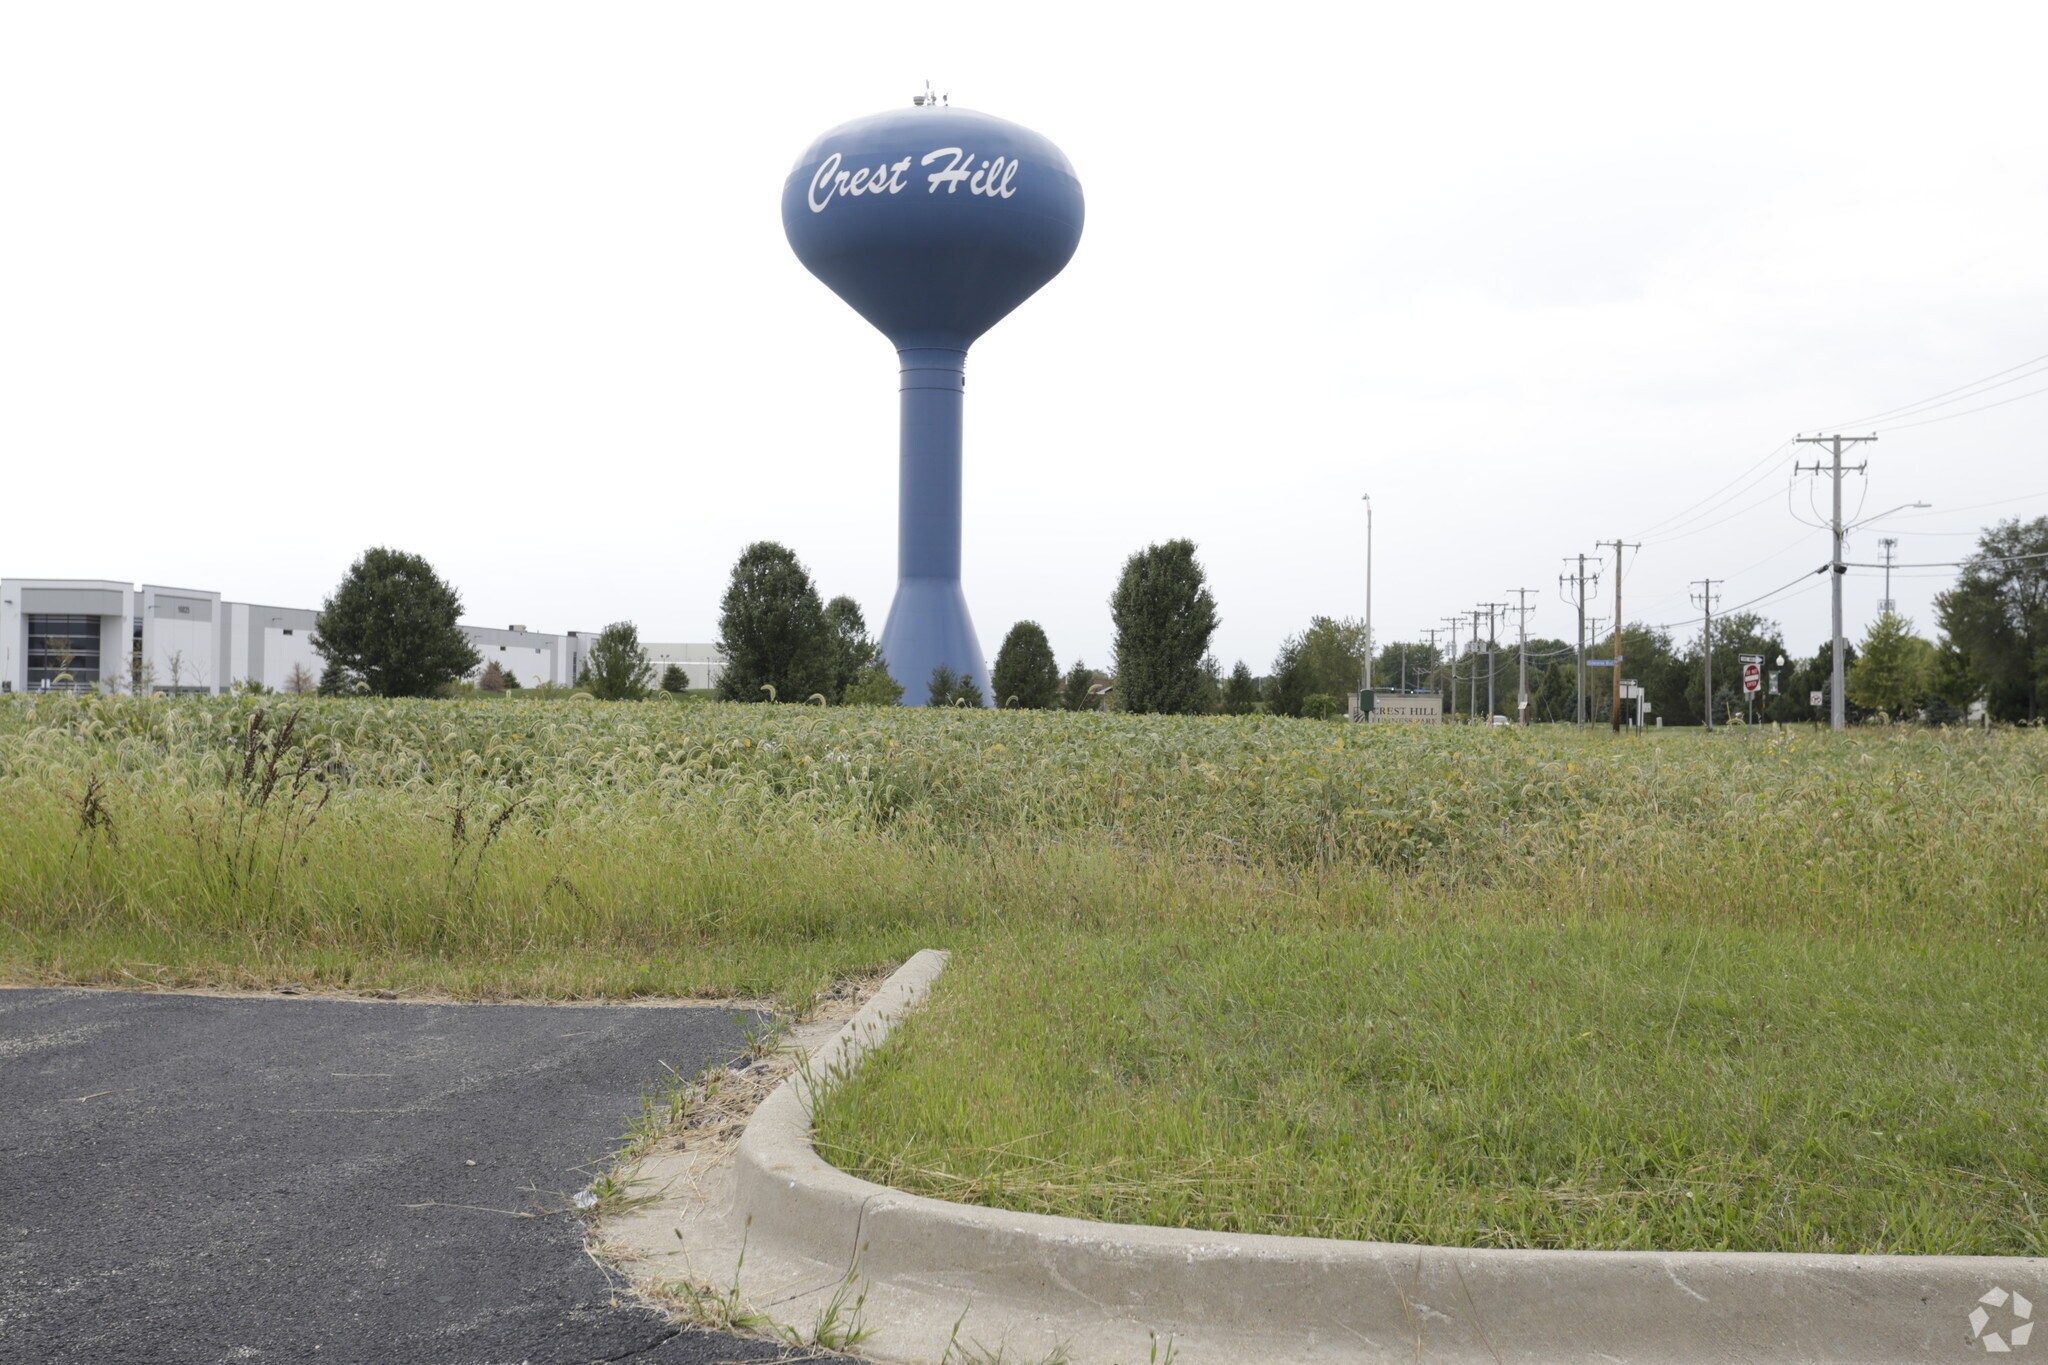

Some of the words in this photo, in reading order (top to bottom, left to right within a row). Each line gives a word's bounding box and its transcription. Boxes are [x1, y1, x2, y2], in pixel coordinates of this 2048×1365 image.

[808, 152, 912, 213] Crest
[921, 147, 1019, 199] Hill
[1410, 707, 1438, 716] HILL
